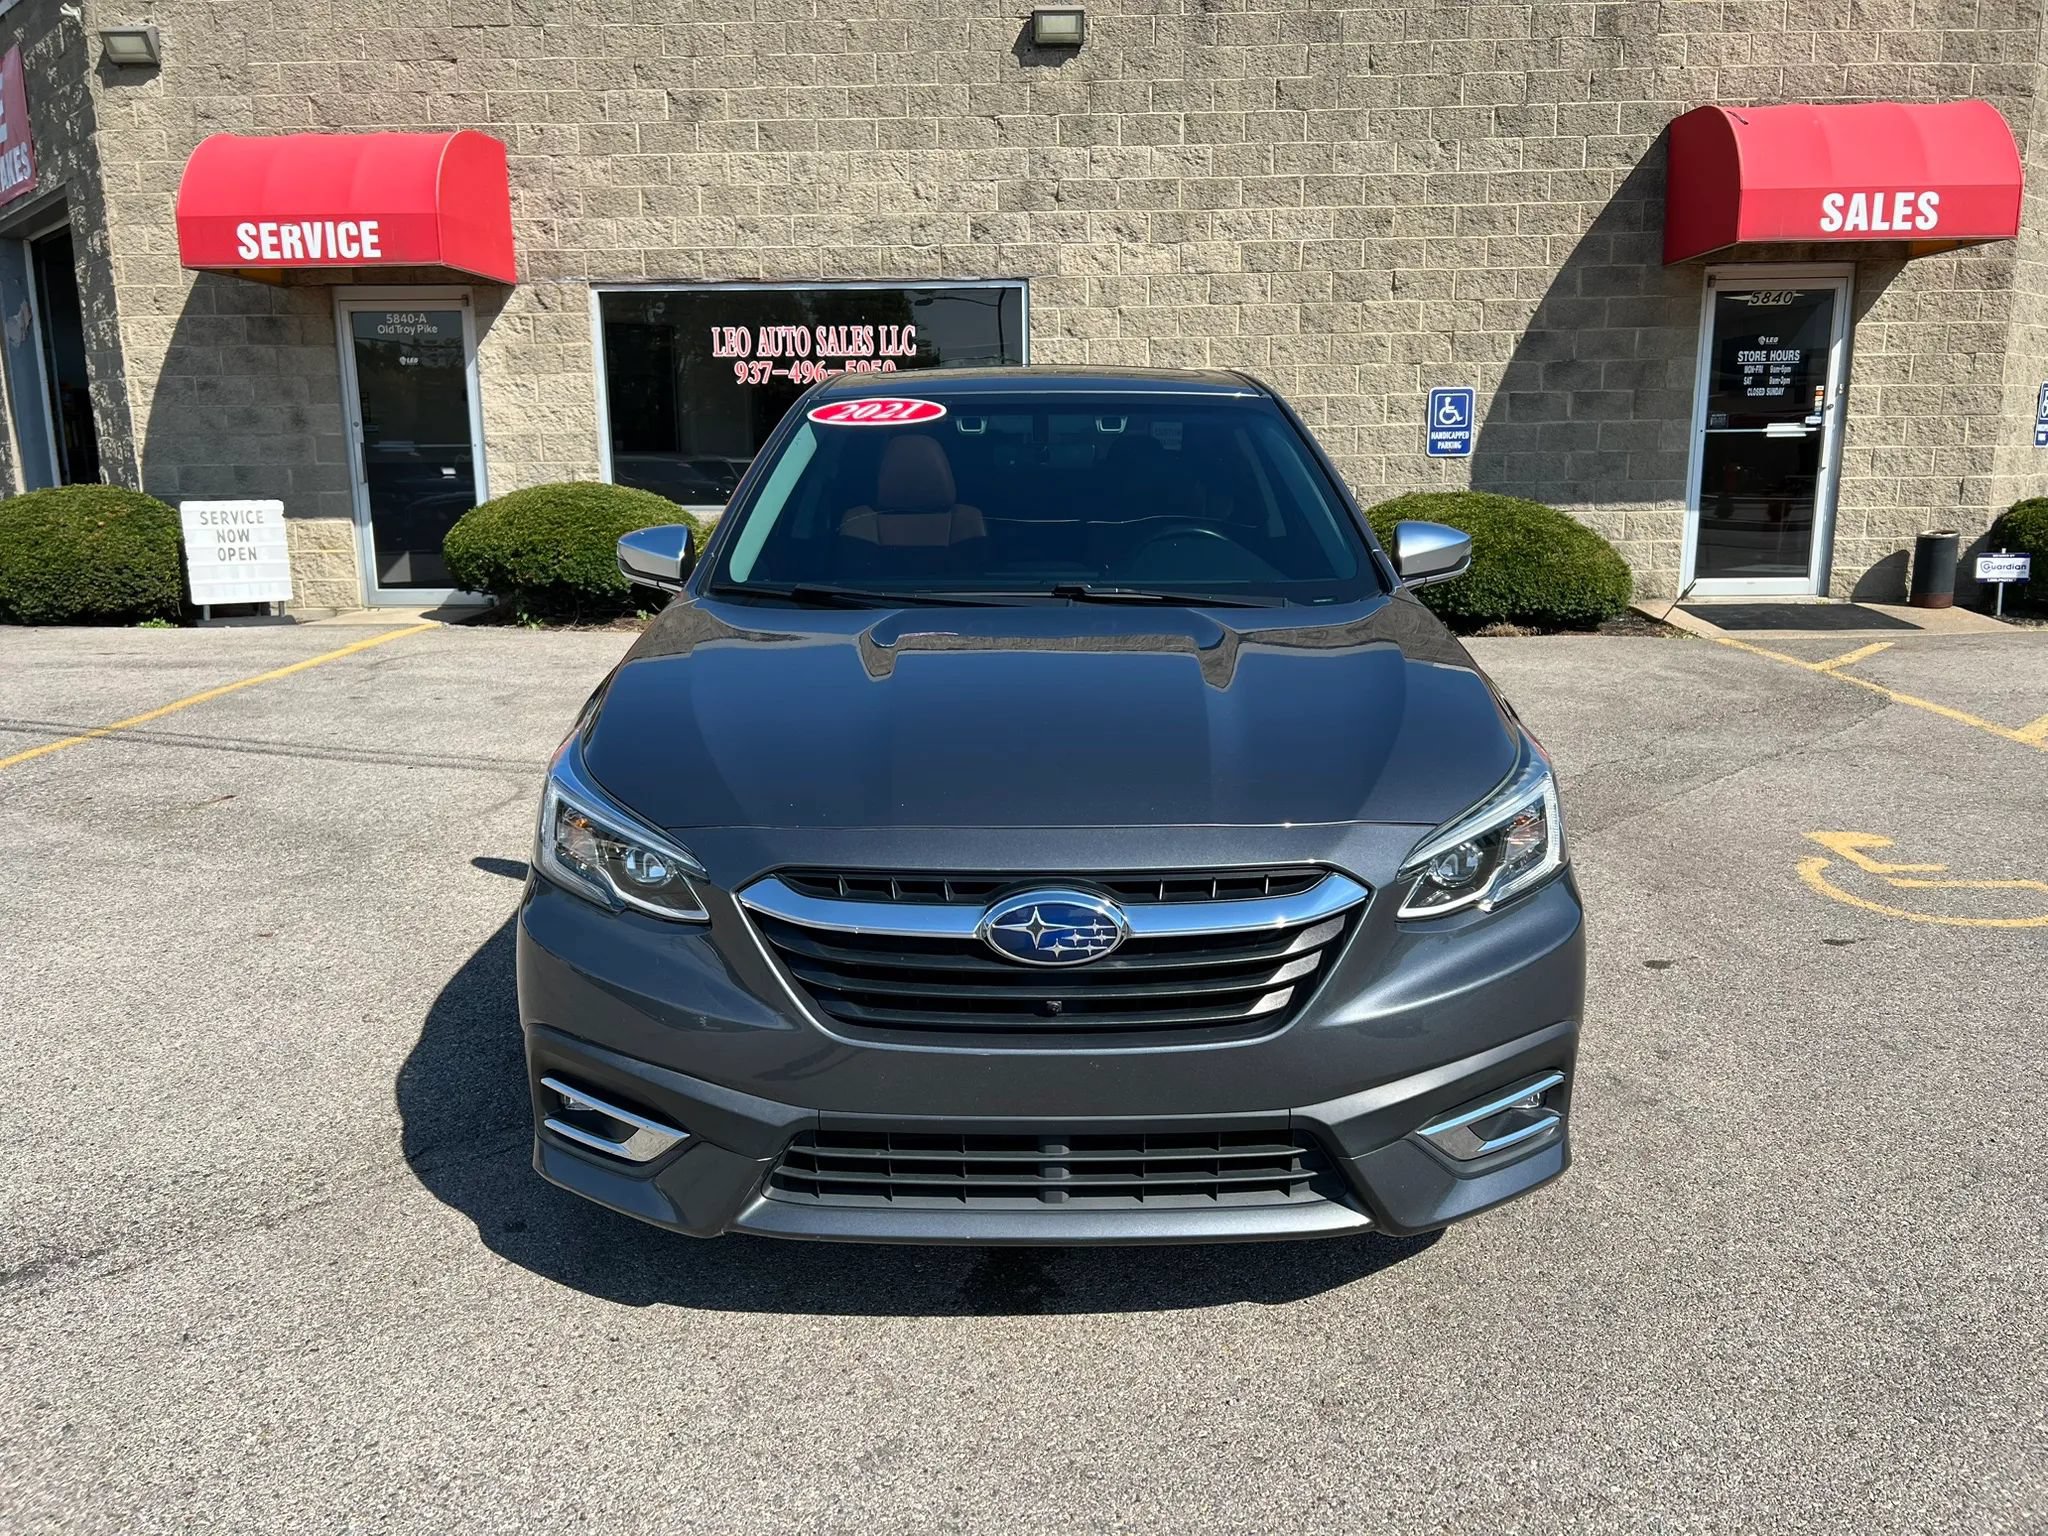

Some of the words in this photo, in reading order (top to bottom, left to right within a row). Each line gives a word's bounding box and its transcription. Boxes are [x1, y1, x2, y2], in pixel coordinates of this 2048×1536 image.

[1819, 190, 1940, 232] SALES
[235, 220, 382, 260] SERVICE
[1750, 291, 1793, 304] 5840
[386, 313, 427, 324] 5840-A
[377, 324, 395, 334] Old
[395, 324, 416, 336] Troy
[417, 324, 438, 334] Pike
[711, 326, 751, 357] LEO
[757, 326, 812, 357] AUTO
[816, 325, 875, 356] SALES
[879, 325, 917, 355] LLC
[1737, 350, 1767, 362] STORE
[1769, 350, 1800, 361] HOURS
[1743, 376, 1753, 385] SAT
[1746, 387, 1766, 396] CLOSED
[1766, 387, 1785, 396] SUNDAY
[826, 402, 925, 421] 2021
[1431, 431, 1469, 439] HANDICAPPED
[1437, 441, 1462, 449] PARKING
[200, 510, 264, 526] SERVICE
[216, 528, 250, 543] NOW
[217, 547, 257, 562] OPEN
[1982, 563, 2027, 571] Guardian
